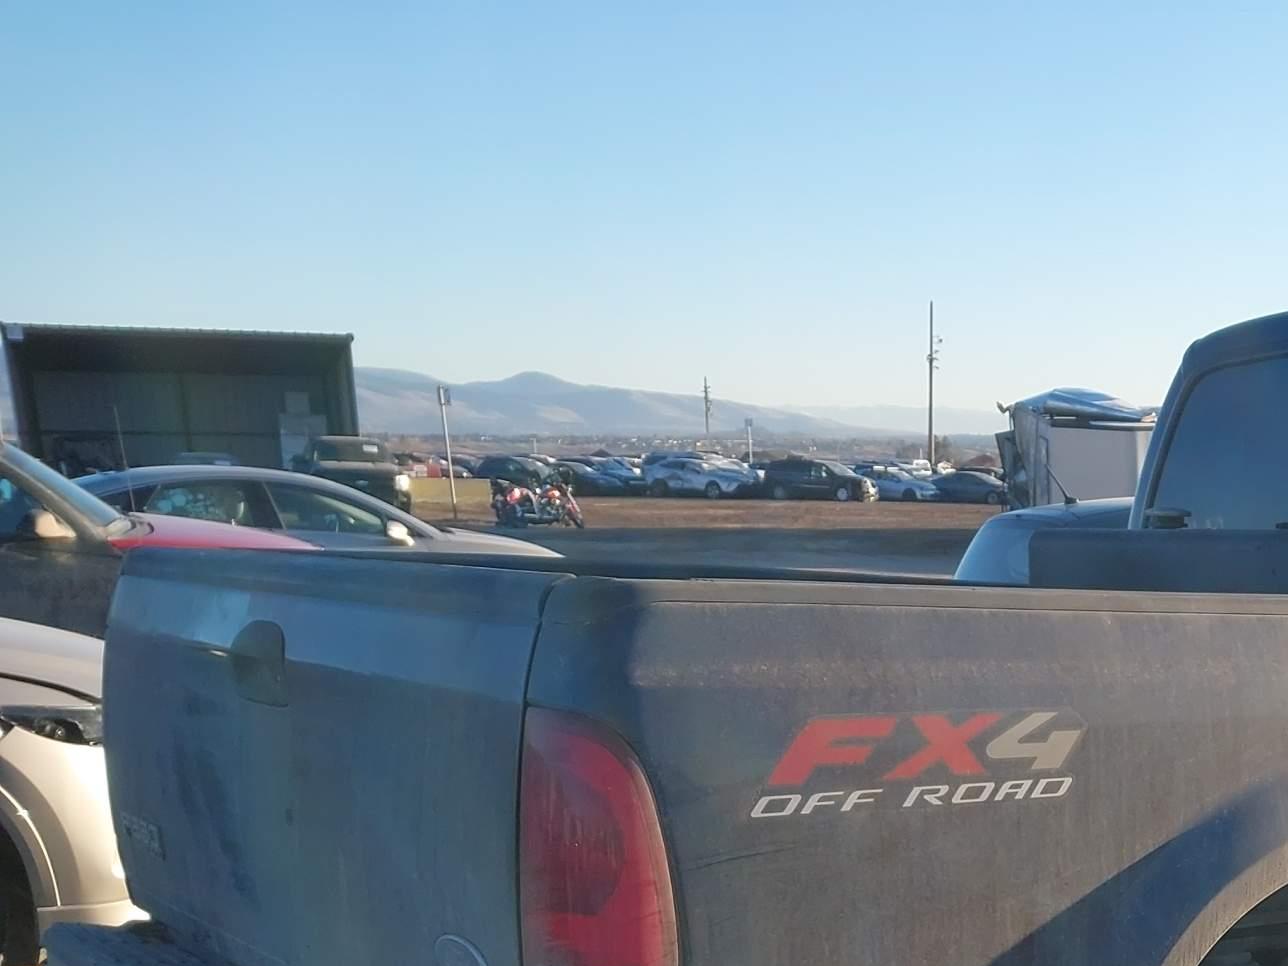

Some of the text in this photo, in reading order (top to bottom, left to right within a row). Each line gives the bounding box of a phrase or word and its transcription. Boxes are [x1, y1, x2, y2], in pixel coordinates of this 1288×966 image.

[767, 711, 1083, 786] FX4
[750, 776, 1073, 818] OFF ROAD
